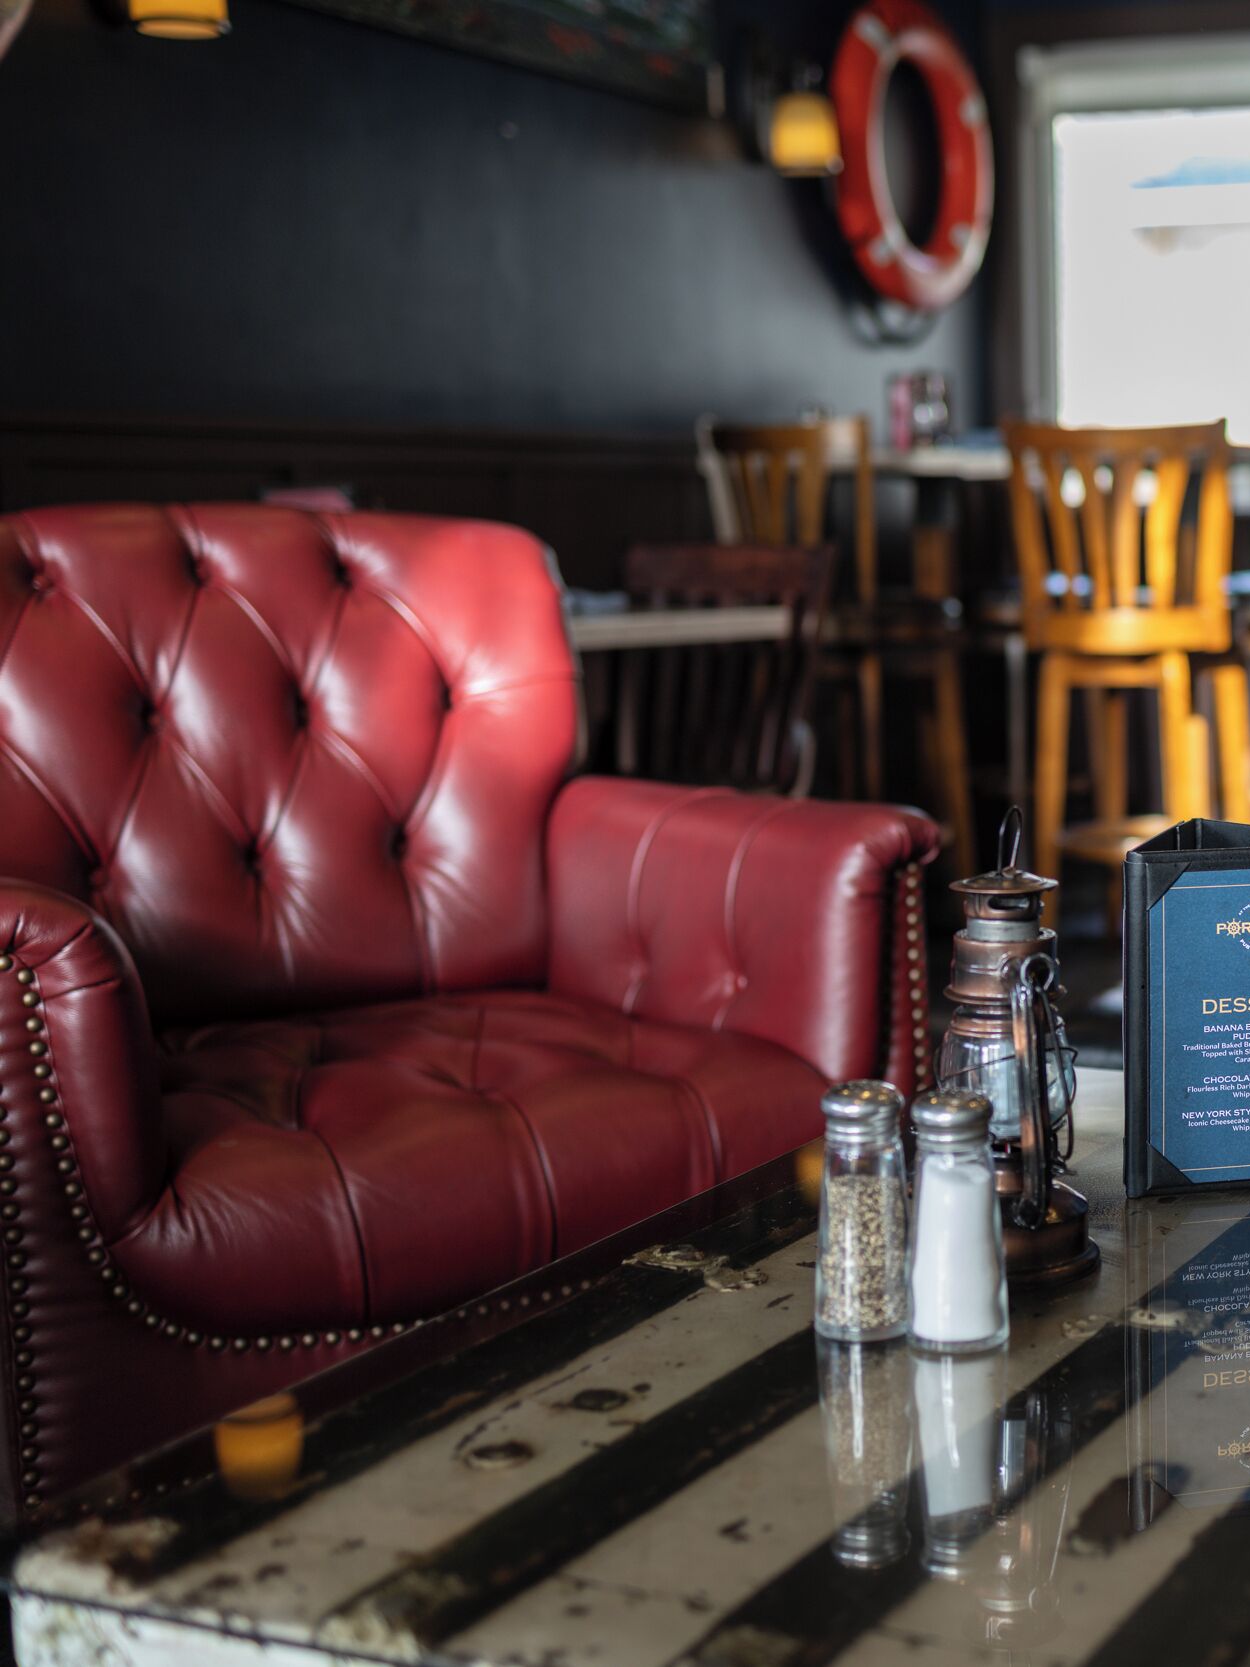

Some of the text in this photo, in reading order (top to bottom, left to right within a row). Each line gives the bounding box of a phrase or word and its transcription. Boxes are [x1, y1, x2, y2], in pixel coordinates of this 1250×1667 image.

[1240, 939, 1250, 949] PUB
[1204, 1024, 1243, 1032] BANANA
[1183, 1043, 1220, 1051] Traditional
[1187, 1085, 1218, 1093] Flourless
[1207, 1110, 1231, 1118] YORK
